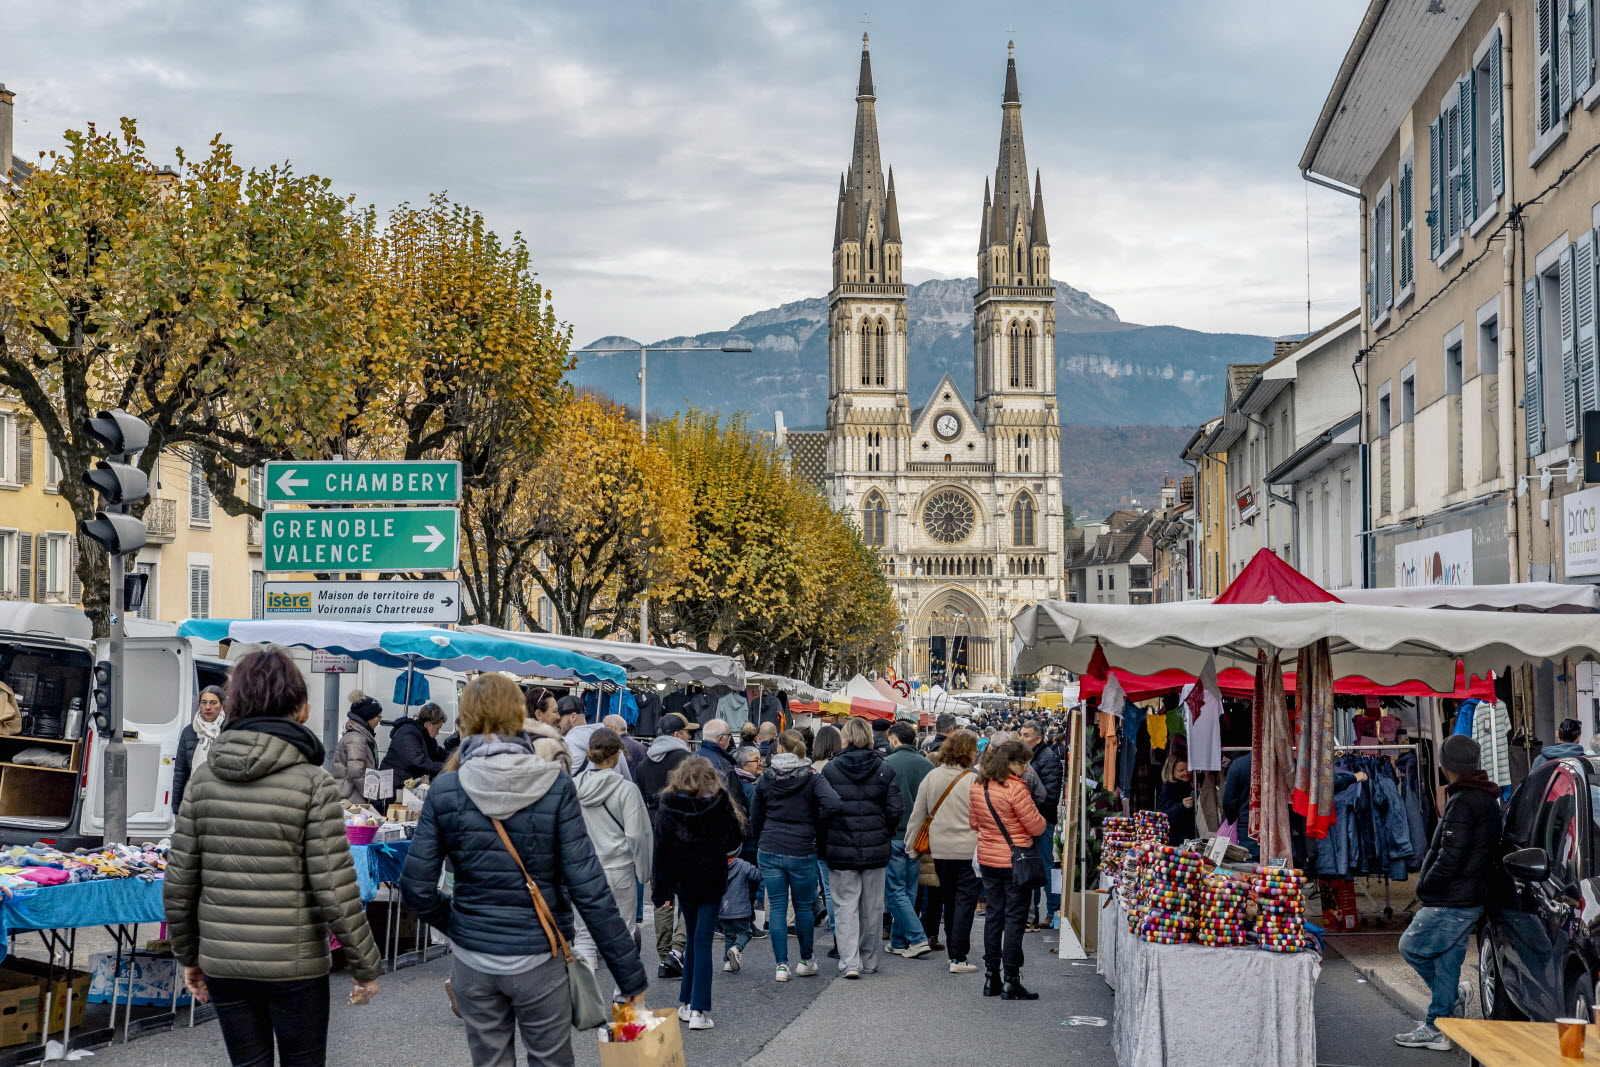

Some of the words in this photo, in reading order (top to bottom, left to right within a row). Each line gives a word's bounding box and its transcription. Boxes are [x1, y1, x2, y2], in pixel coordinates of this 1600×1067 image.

[325, 472, 449, 492] CHAMBERY
[272, 518, 395, 538] GRENOBLE
[273, 543, 373, 563] VALENCE
[1568, 538, 1597, 555] BOUTIQUE
[268, 591, 309, 608] isère
[318, 590, 354, 600] Maison
[357, 590, 369, 600] de
[373, 590, 419, 600] territoire
[423, 590, 435, 600] de
[317, 604, 372, 614] Voironnais
[376, 604, 434, 614] Chartreuse
